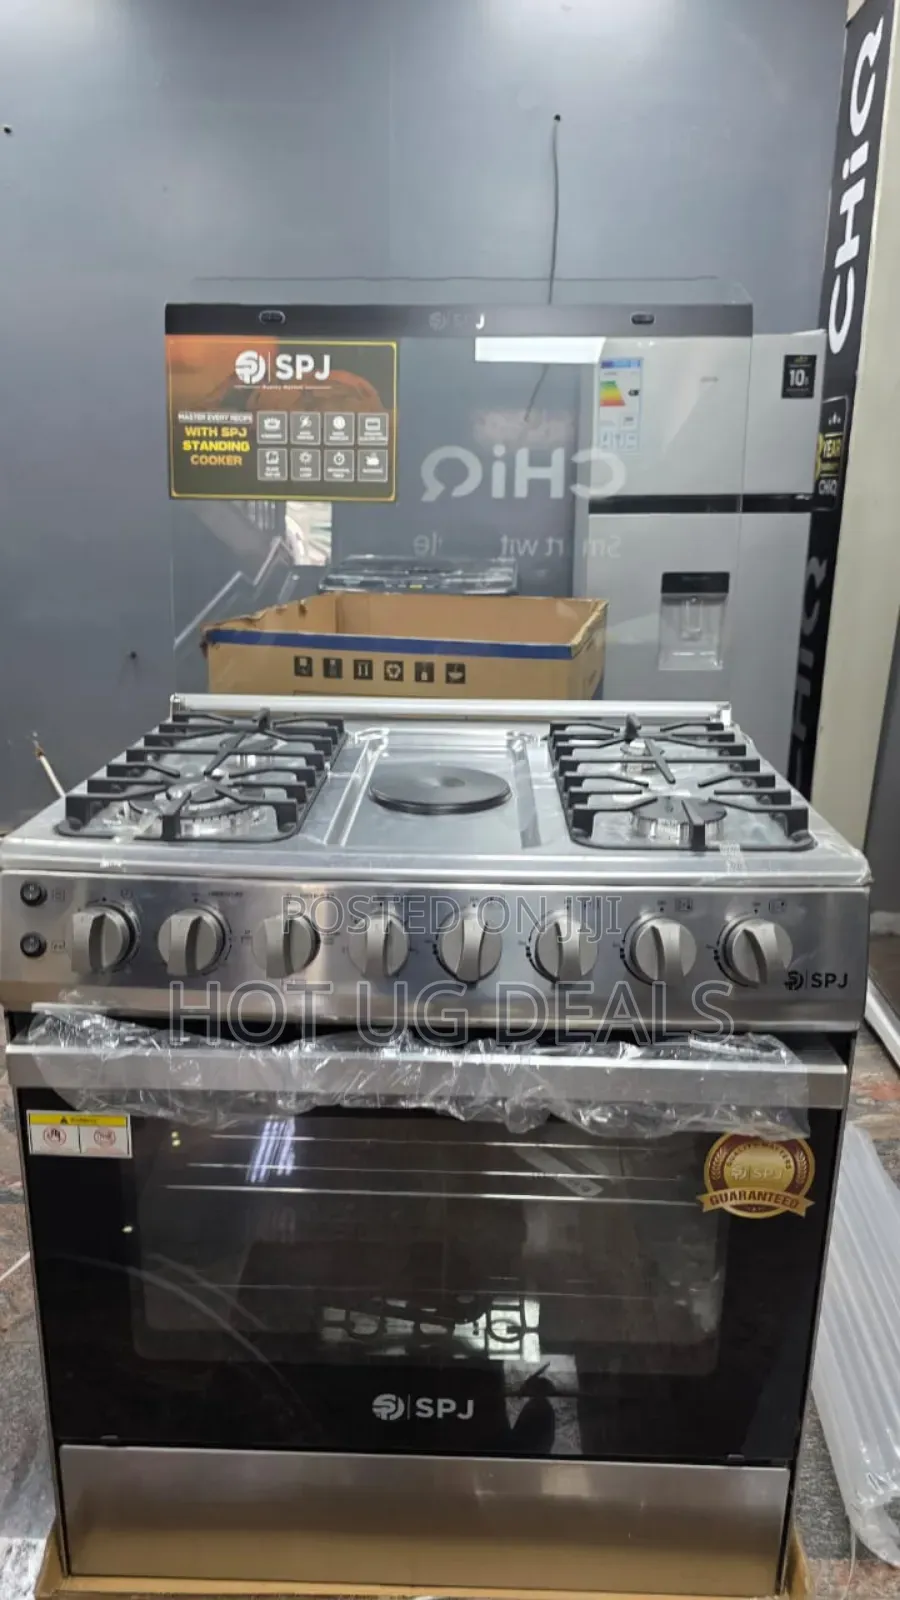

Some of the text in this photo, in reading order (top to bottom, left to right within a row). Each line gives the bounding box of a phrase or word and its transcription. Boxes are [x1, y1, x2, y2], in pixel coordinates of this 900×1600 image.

[827, 15, 884, 354] CHiQ
[276, 353, 330, 381] SPJ
[184, 426, 218, 437] WITH
[221, 427, 247, 438] SPJ
[183, 440, 250, 452] STANDING
[190, 454, 243, 466] COOKER
[811, 973, 848, 989] SPJ
[753, 1167, 784, 1180] SPJ
[709, 1190, 800, 1209] GUARANTEED
[415, 1398, 474, 1420] SPJ
